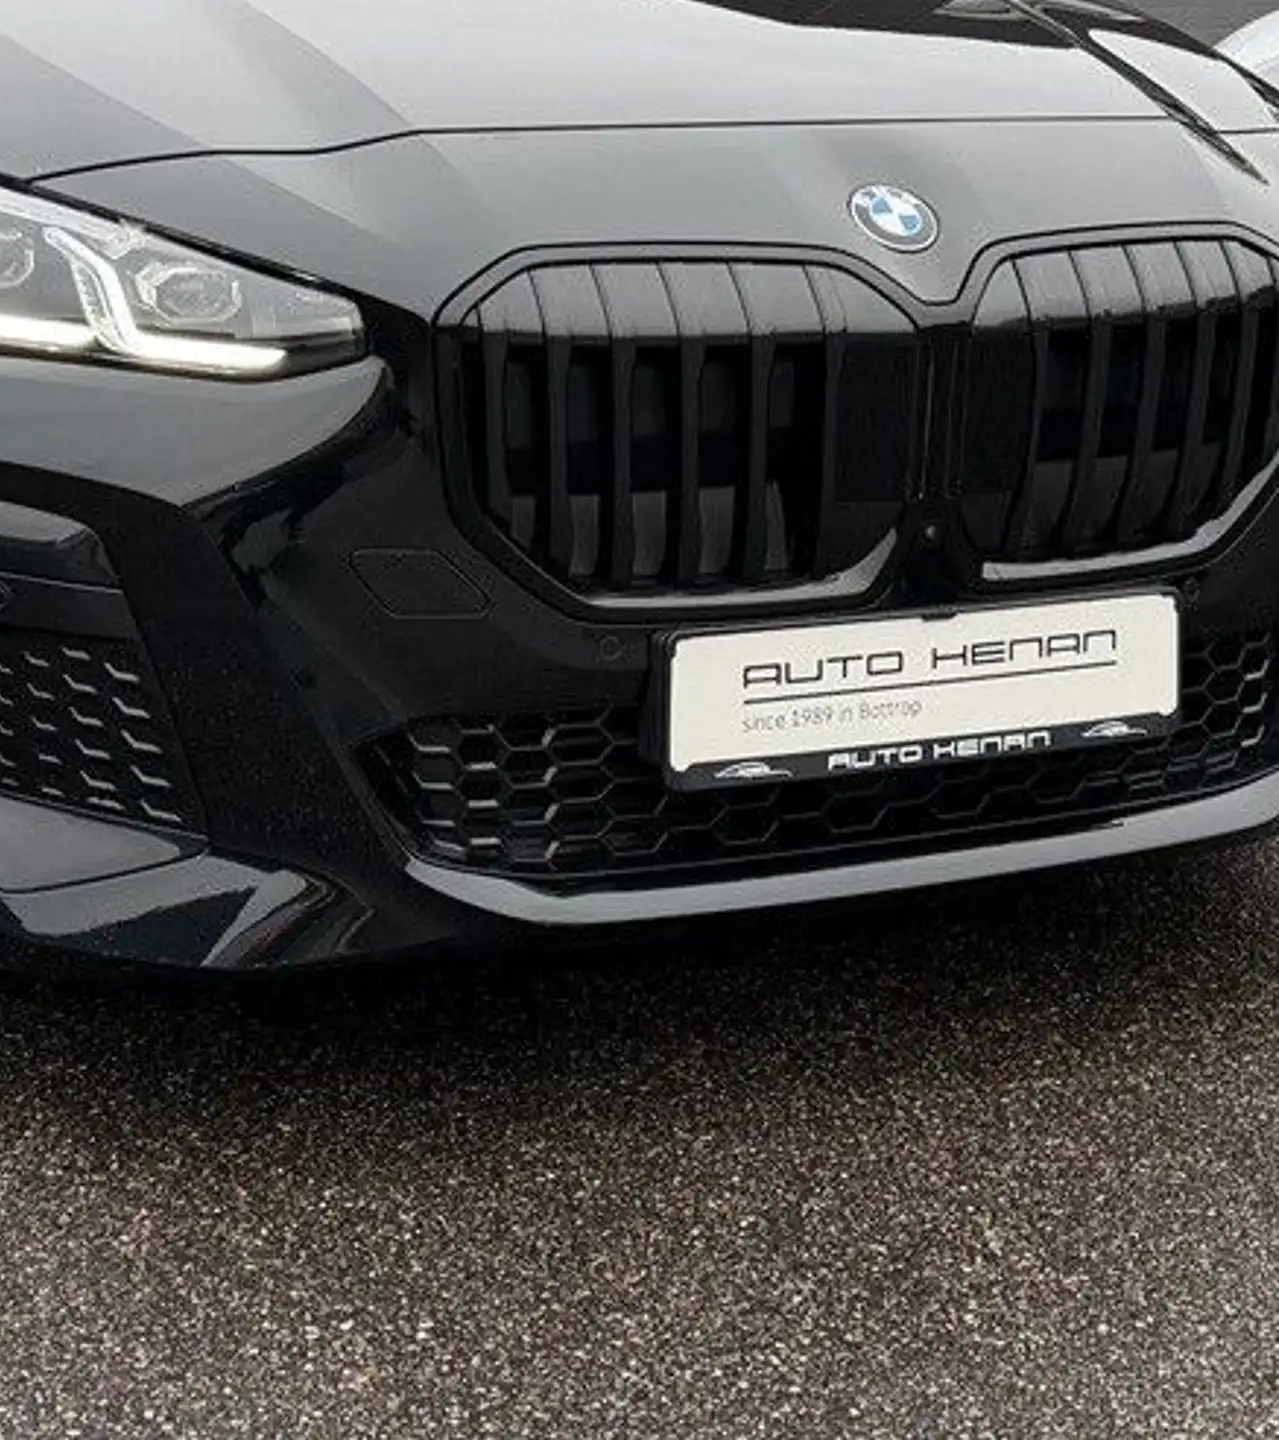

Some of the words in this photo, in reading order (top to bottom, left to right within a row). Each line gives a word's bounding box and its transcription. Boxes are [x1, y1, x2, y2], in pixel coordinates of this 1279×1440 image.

[743, 650, 903, 690] AUTO
[742, 711, 785, 733] since
[792, 705, 833, 728] 1989
[839, 706, 853, 724] in
[827, 744, 923, 771] AUTO
